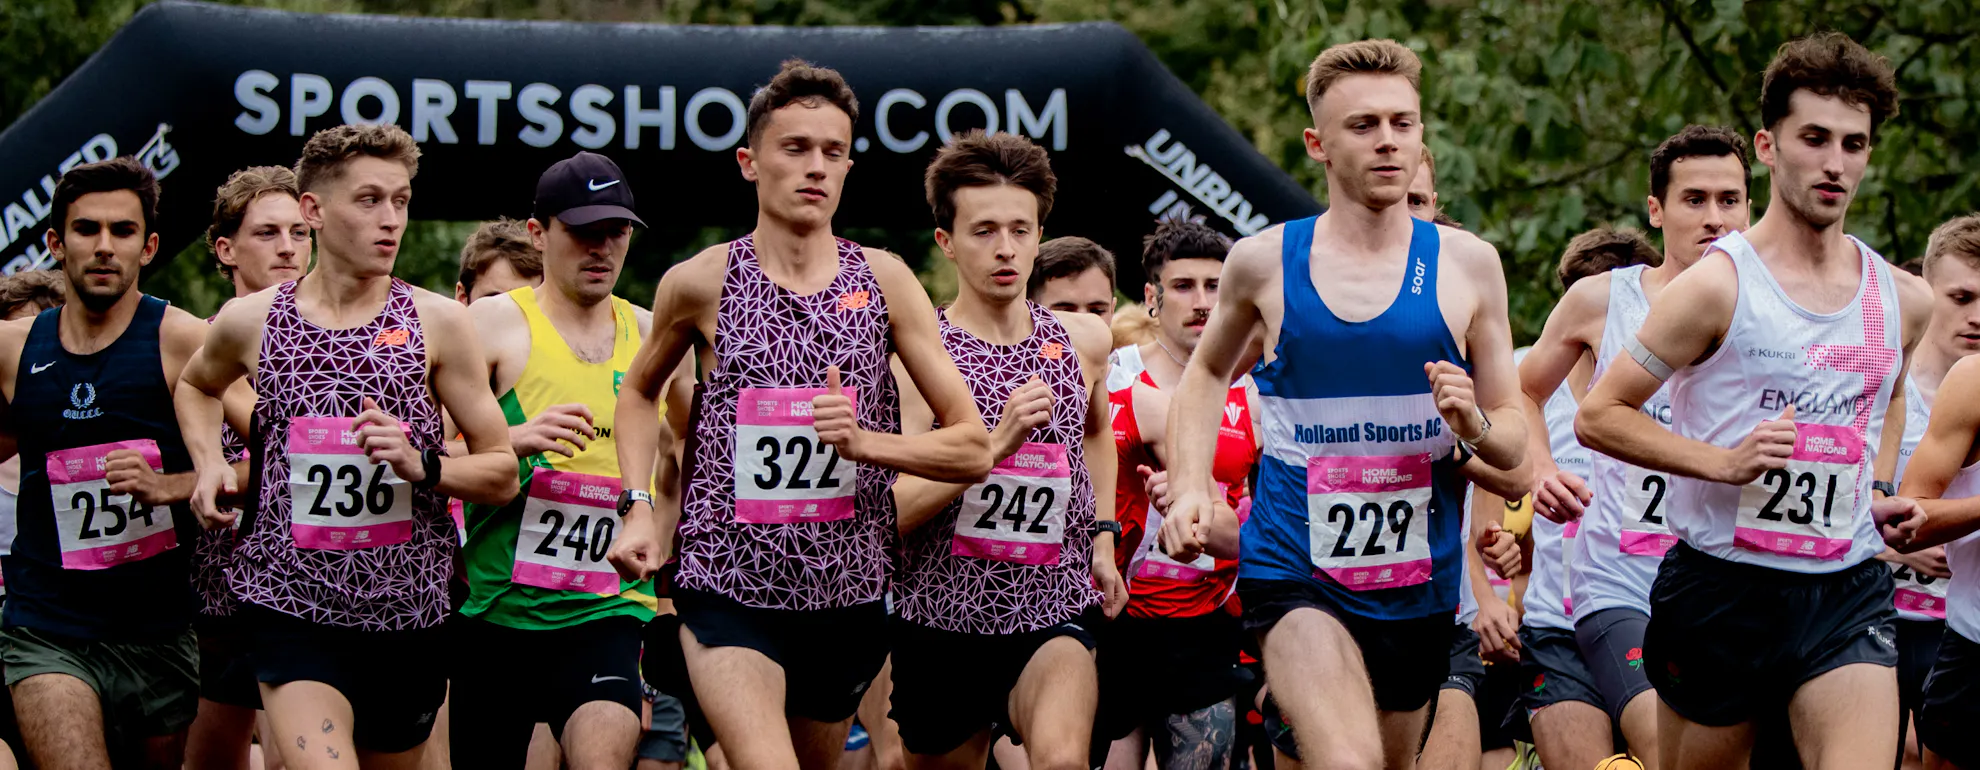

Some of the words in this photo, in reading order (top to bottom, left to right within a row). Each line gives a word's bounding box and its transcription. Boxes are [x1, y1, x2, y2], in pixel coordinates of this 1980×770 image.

[234, 69, 1068, 153] SPORTSSHO.COM
[0, 133, 118, 250] ALLD
[1145, 128, 1276, 237] UNRIV
[1411, 257, 1426, 295] soar
[1758, 349, 1796, 359] KUKRI
[790, 401, 815, 409] HOM
[1759, 388, 1868, 416] ENGLAND
[1294, 423, 1360, 444] Holland
[1364, 422, 1422, 443] Sports
[1425, 417, 1441, 439] AC
[1805, 435, 1835, 446] HOME
[754, 436, 840, 490] 322
[1014, 453, 1045, 462] HOME
[1804, 443, 1848, 456] NATIONS
[1014, 461, 1058, 470] NATIONS
[1361, 474, 1413, 484] NATIONS
[1362, 468, 1398, 477] HOME
[307, 464, 394, 517] 236
[551, 479, 570, 487] SPORTS
[580, 484, 611, 494] HOME
[973, 483, 1055, 534] 242
[1756, 468, 1838, 528] 231
[71, 487, 154, 540] 254
[533, 509, 615, 563] 240
[1327, 500, 1414, 558] 229
[1875, 629, 1896, 649] KUK
